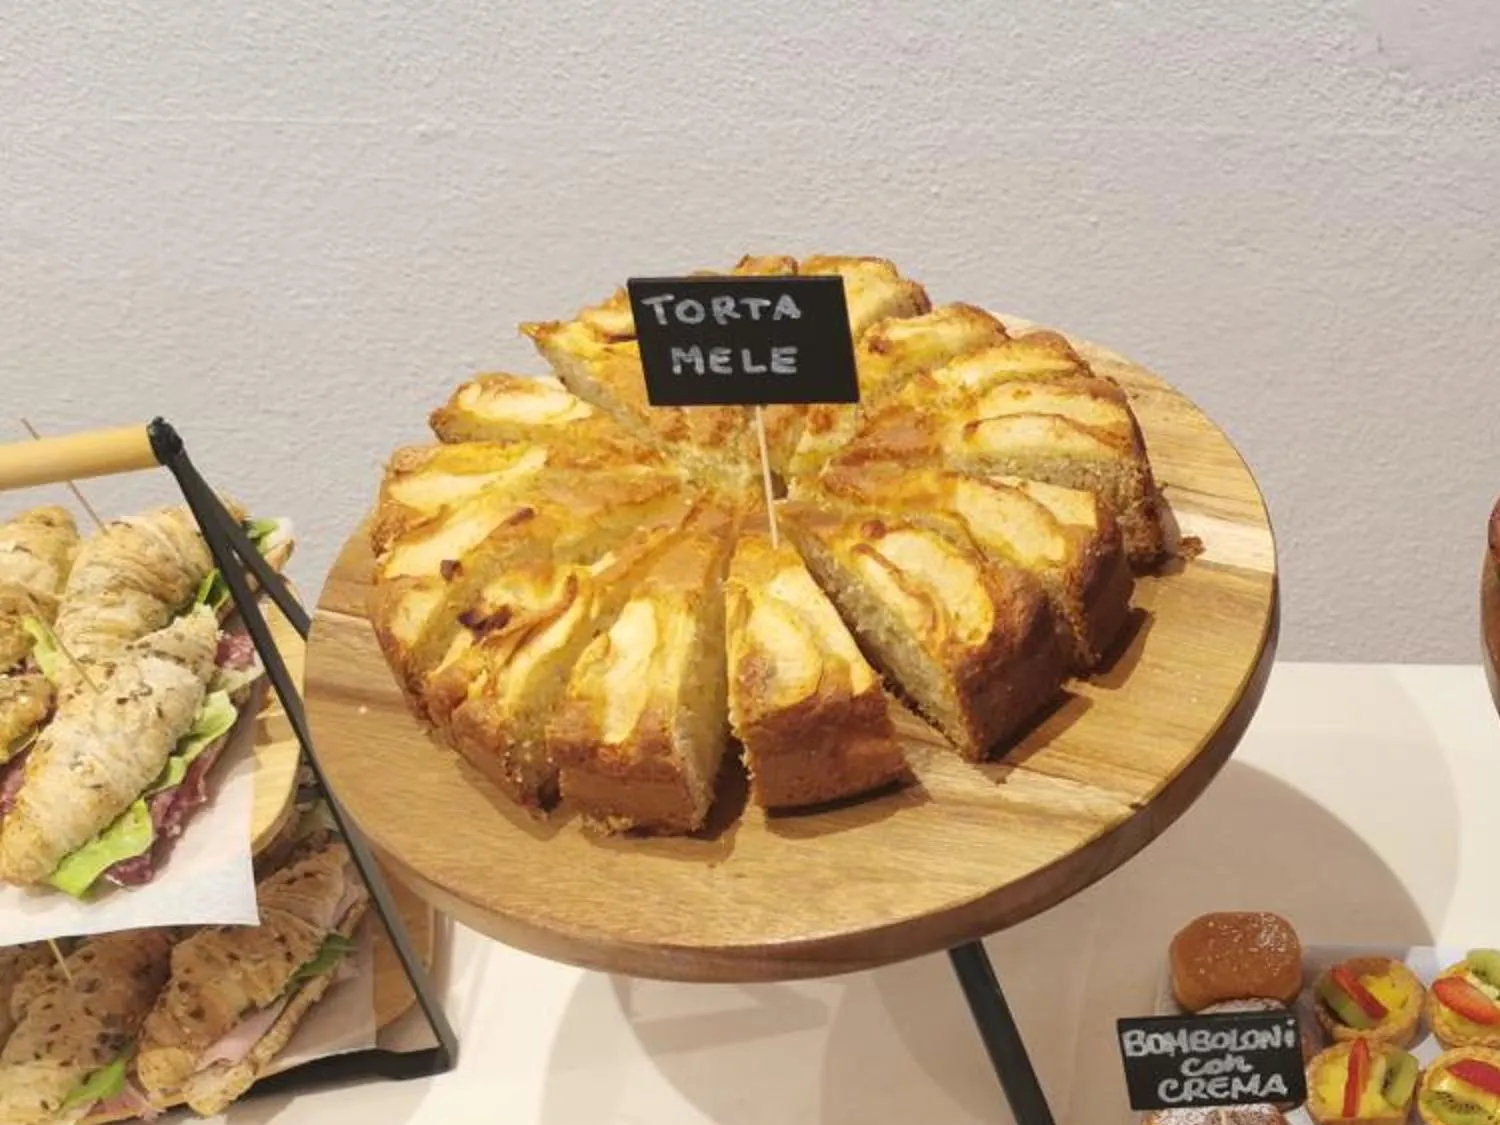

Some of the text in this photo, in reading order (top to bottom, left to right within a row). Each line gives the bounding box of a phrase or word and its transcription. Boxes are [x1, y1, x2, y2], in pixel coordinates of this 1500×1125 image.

[641, 293, 801, 325] TORTA
[671, 344, 798, 375] MELE
[1179, 1053, 1254, 1077] con
[1157, 1072, 1289, 1104] CREMA
